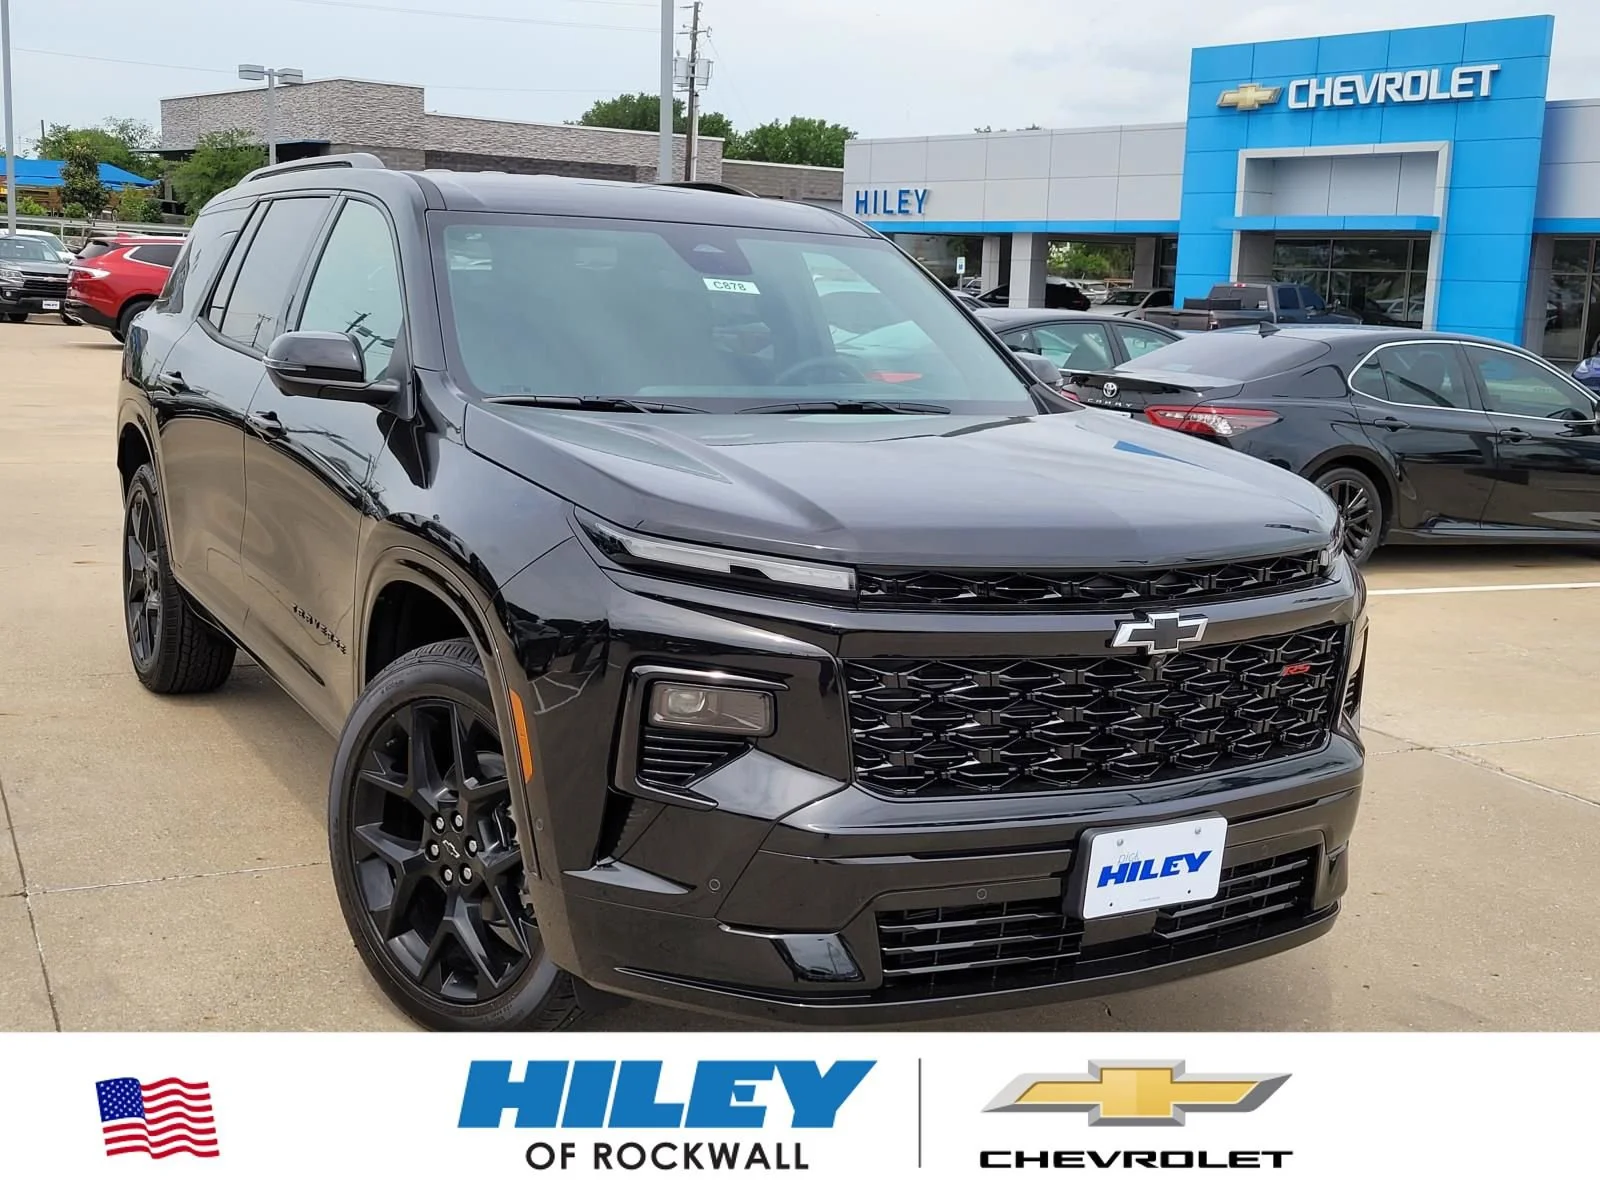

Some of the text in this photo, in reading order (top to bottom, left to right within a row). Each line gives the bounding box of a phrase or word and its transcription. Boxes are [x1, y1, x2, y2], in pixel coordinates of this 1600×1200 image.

[1288, 63, 1500, 109] CHEVROLET
[855, 189, 928, 215] HILEY
[713, 281, 747, 291] C878
[1281, 663, 1311, 677] RS
[1096, 850, 1213, 888] HILEY
